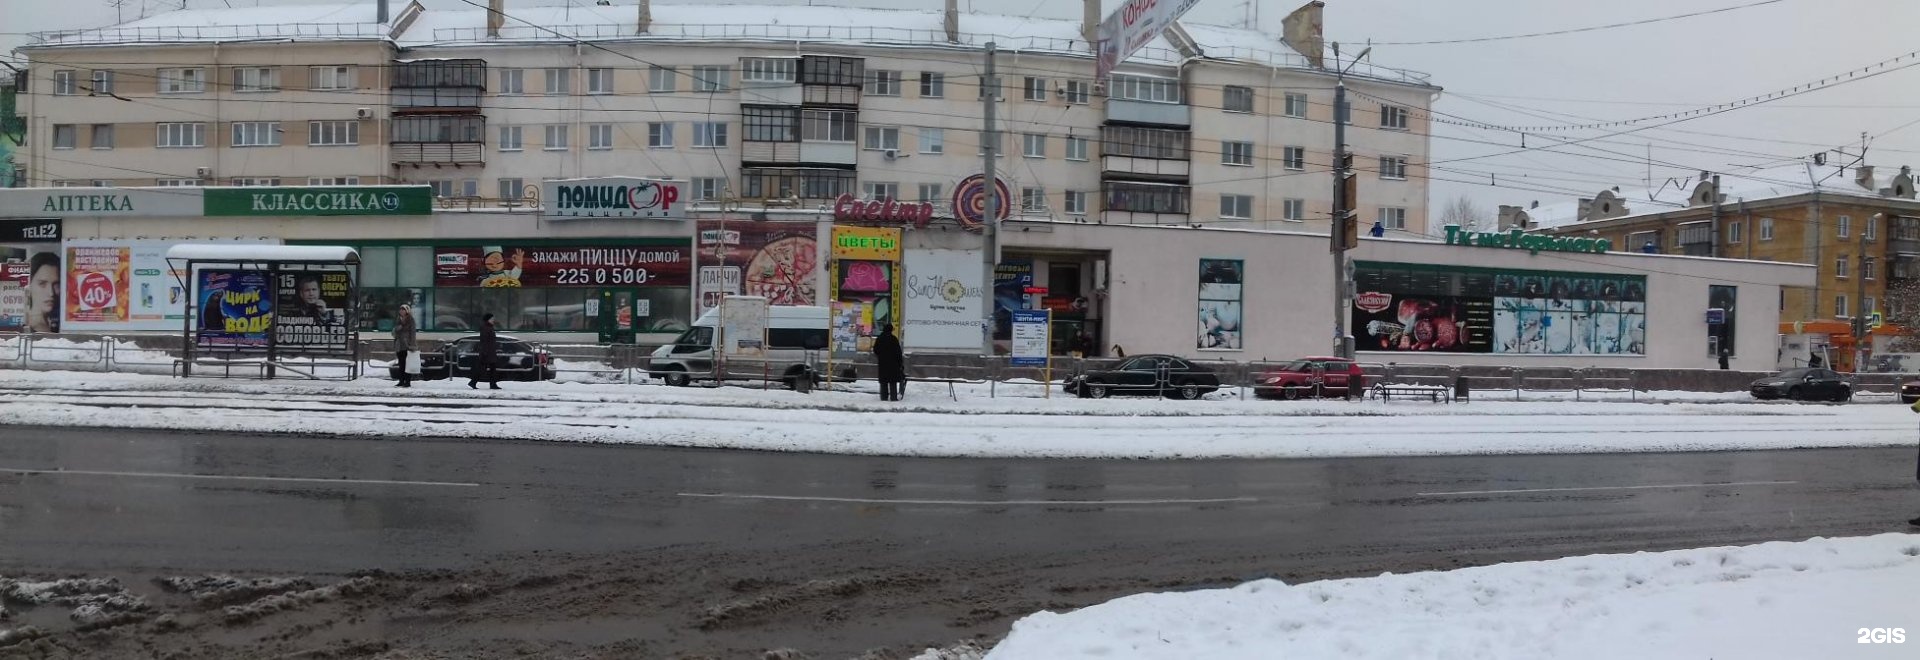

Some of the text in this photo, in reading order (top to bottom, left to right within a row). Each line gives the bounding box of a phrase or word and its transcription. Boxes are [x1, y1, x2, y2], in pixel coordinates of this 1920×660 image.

[43, 195, 134, 211] АПТЕКА
[252, 193, 381, 210] КЛАССИКА
[23, 224, 57, 238] TELE2
[838, 236, 895, 249] ЦВЕТЫ
[531, 249, 680, 266] ЗАКАЖИ ПИЦЦУ ДОМОЙ
[279, 274, 295, 288] 15
[595, 268, 606, 284] 0
[702, 271, 738, 284] ЛАНЧИ
[85, 286, 112, 304] 40%
[225, 289, 260, 306] ЦИРК
[246, 305, 258, 315] НА
[225, 312, 274, 333] ВОДЕ
